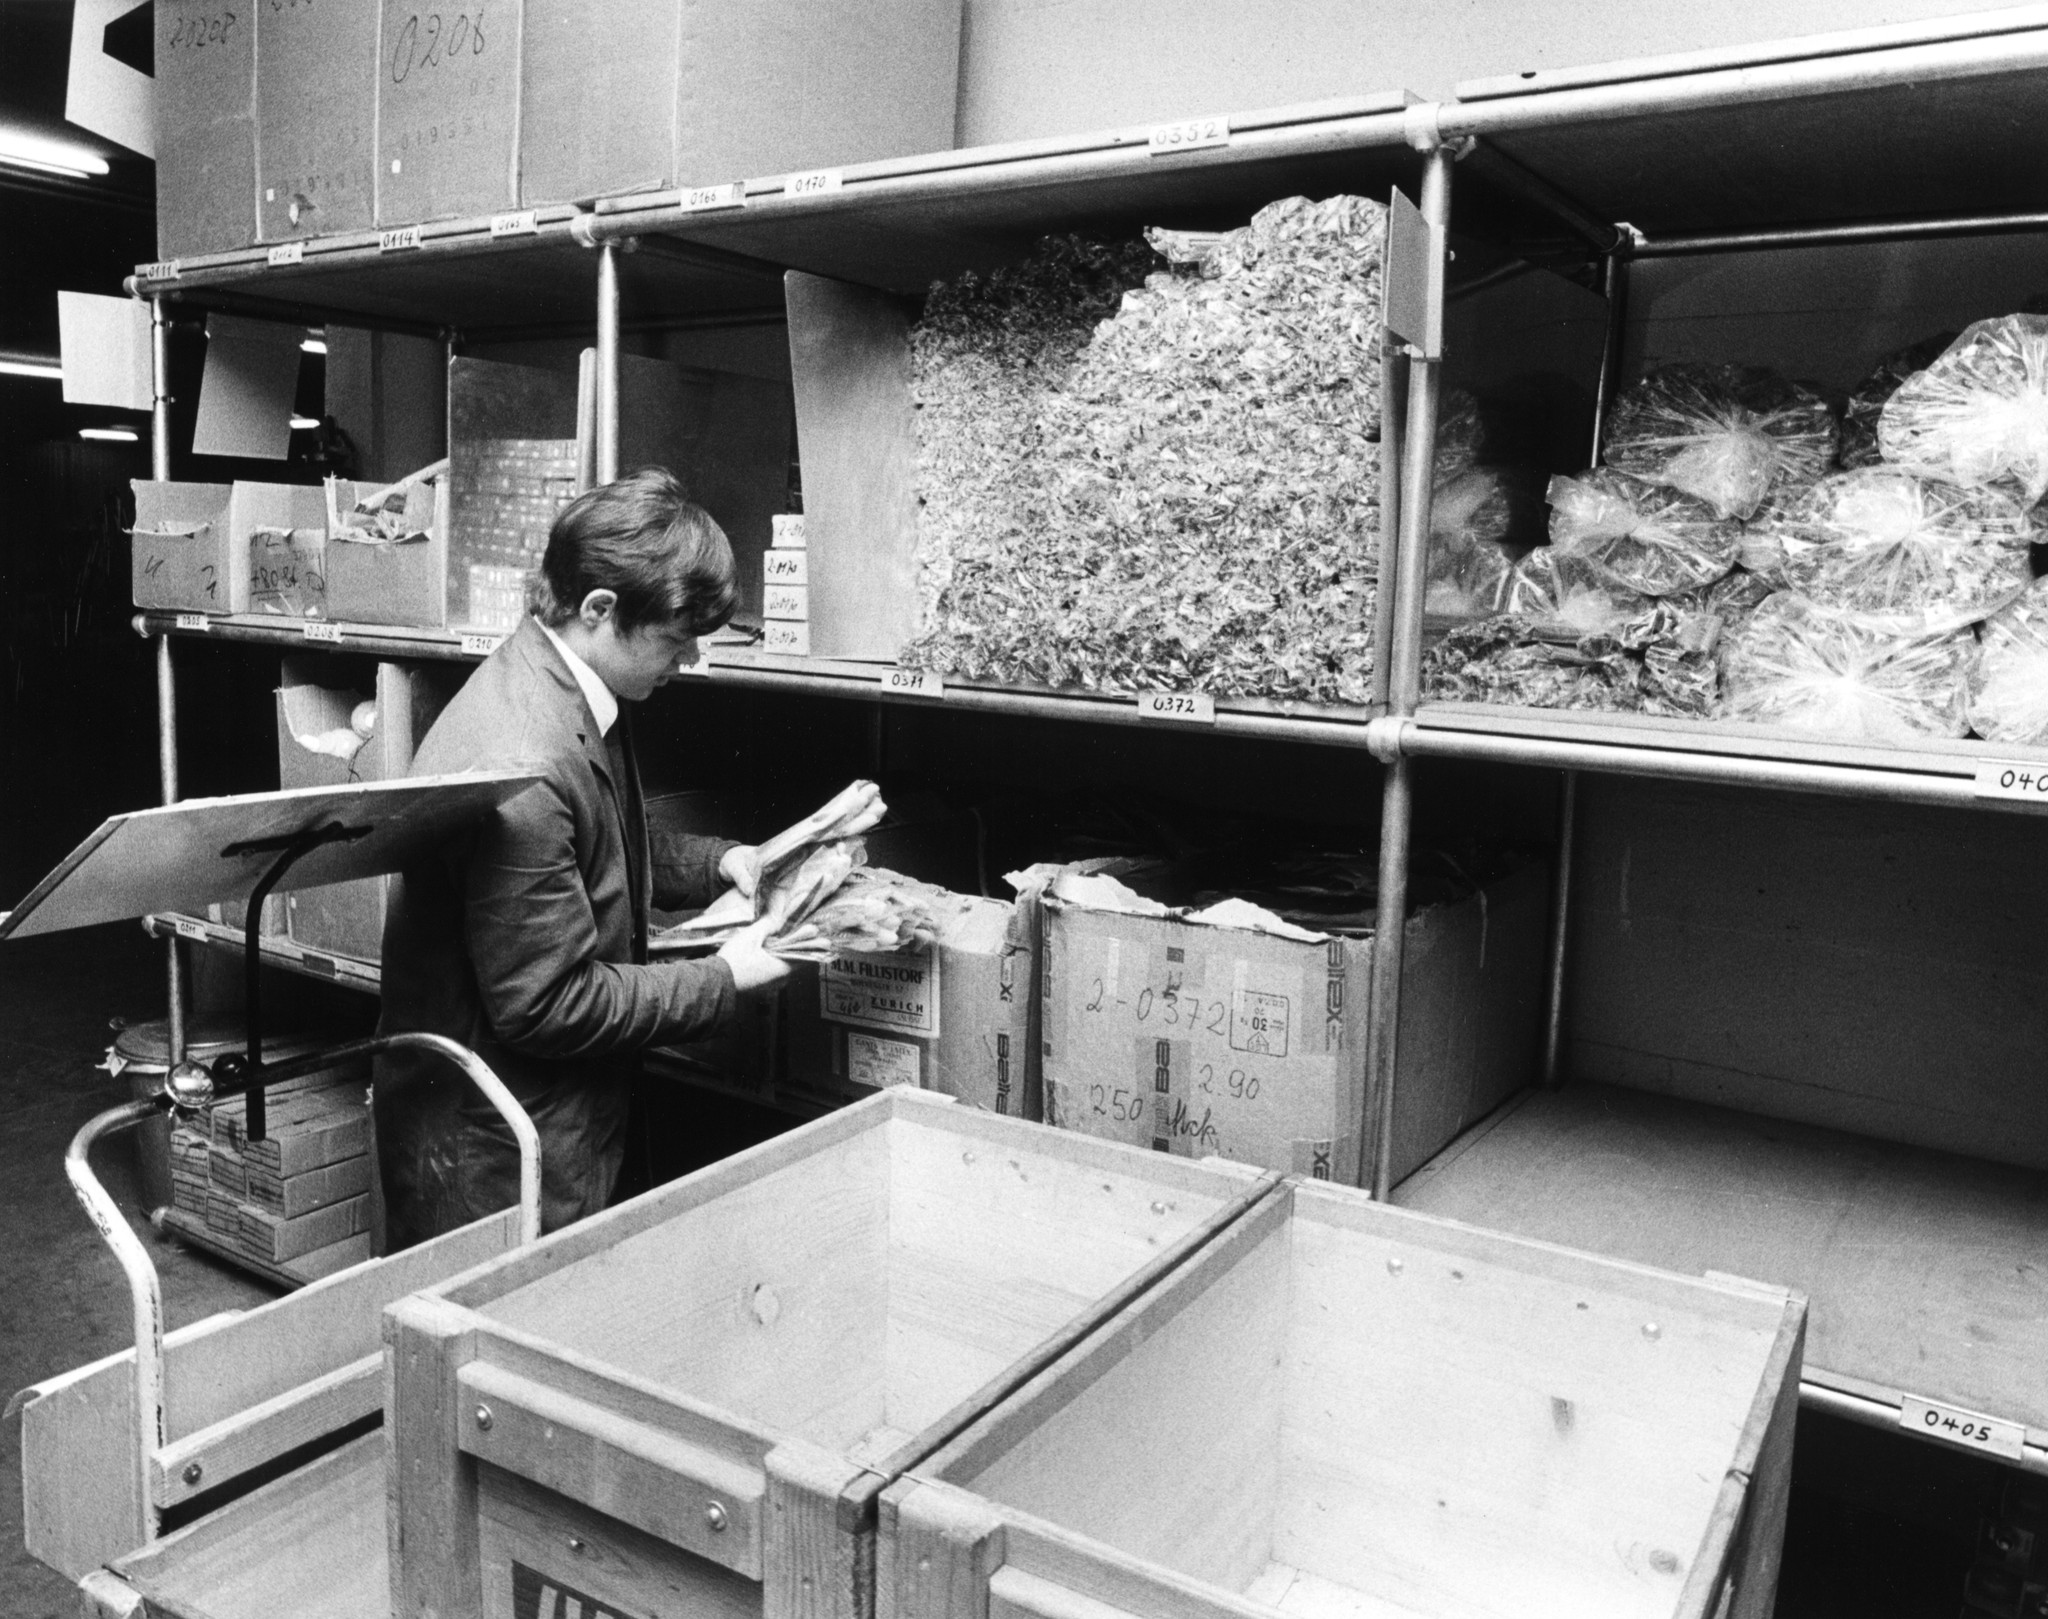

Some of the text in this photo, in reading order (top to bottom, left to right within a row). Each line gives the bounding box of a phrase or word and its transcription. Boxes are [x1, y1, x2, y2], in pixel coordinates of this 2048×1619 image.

[392, 9, 486, 83] 0208
[1155, 121, 1219, 145] 0352
[795, 175, 826, 192] 0170
[383, 232, 414, 247] 0114
[891, 673, 924, 689] 0371
[1153, 697, 1196, 713] 0372
[1090, 1083, 1143, 1121] 250
[1924, 1409, 1993, 1443] 0405
